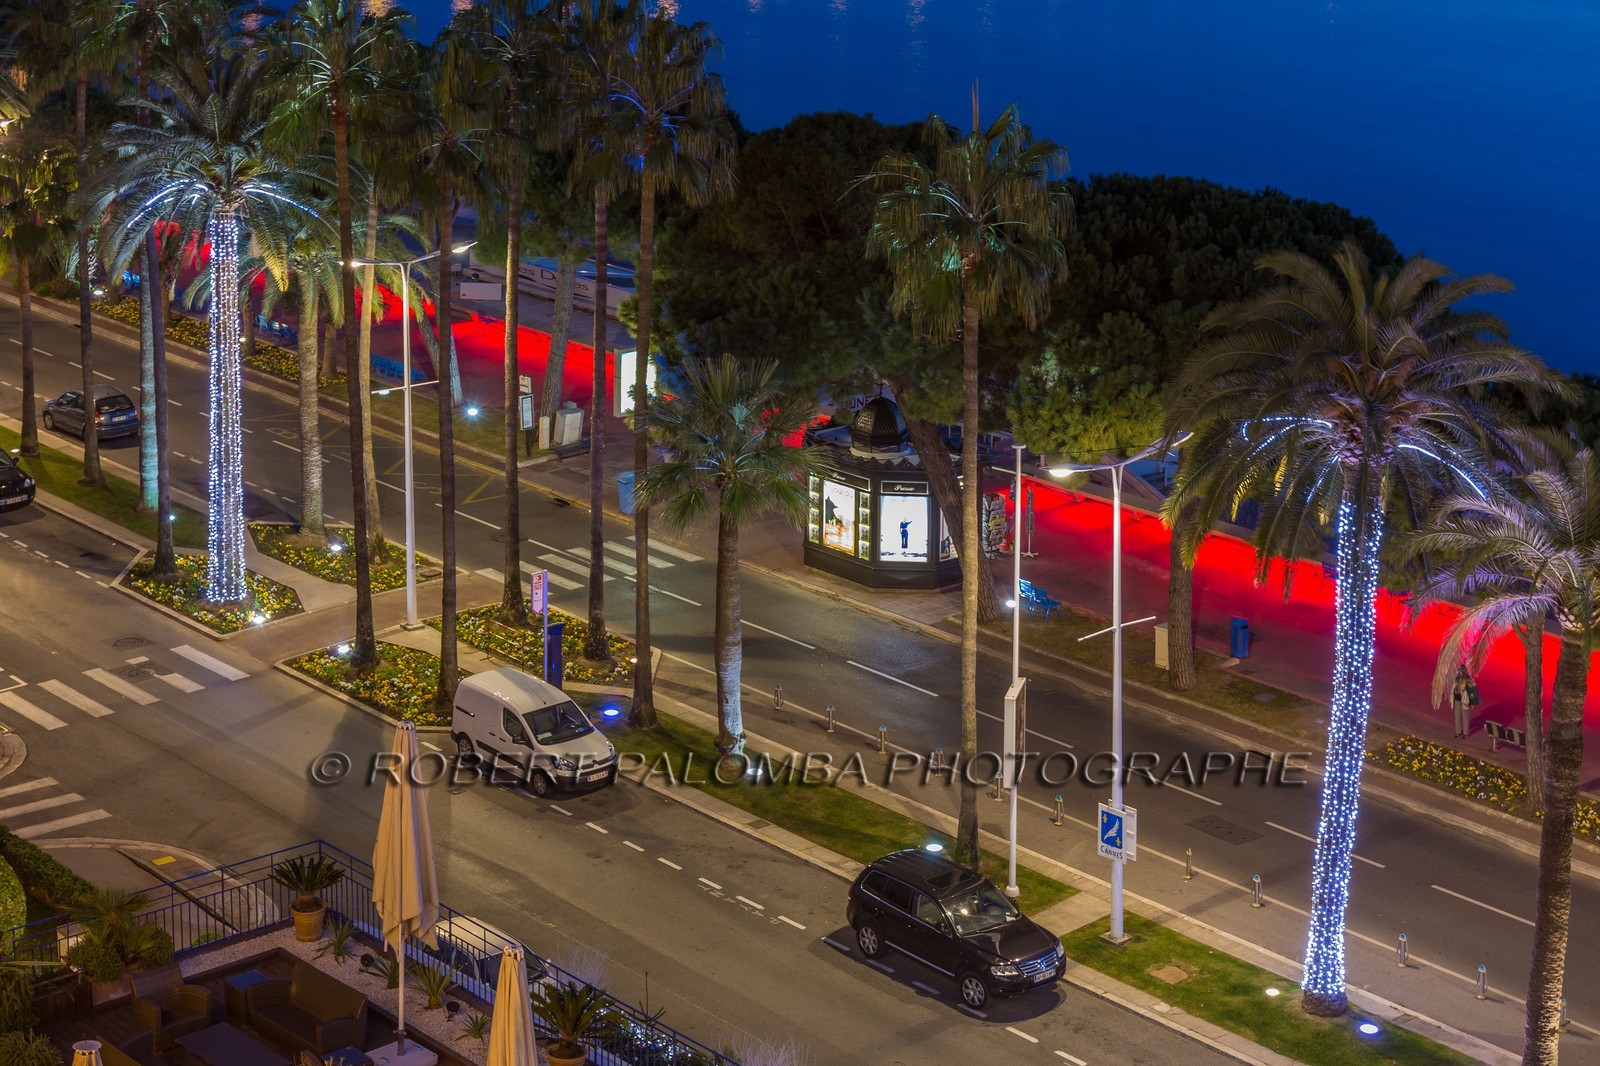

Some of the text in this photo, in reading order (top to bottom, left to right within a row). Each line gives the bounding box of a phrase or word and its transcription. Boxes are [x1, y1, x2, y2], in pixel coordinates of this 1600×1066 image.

[540, 268, 589, 291] Des
[893, 484, 915, 492] Presse
[1100, 845, 1123, 860] CANNES
